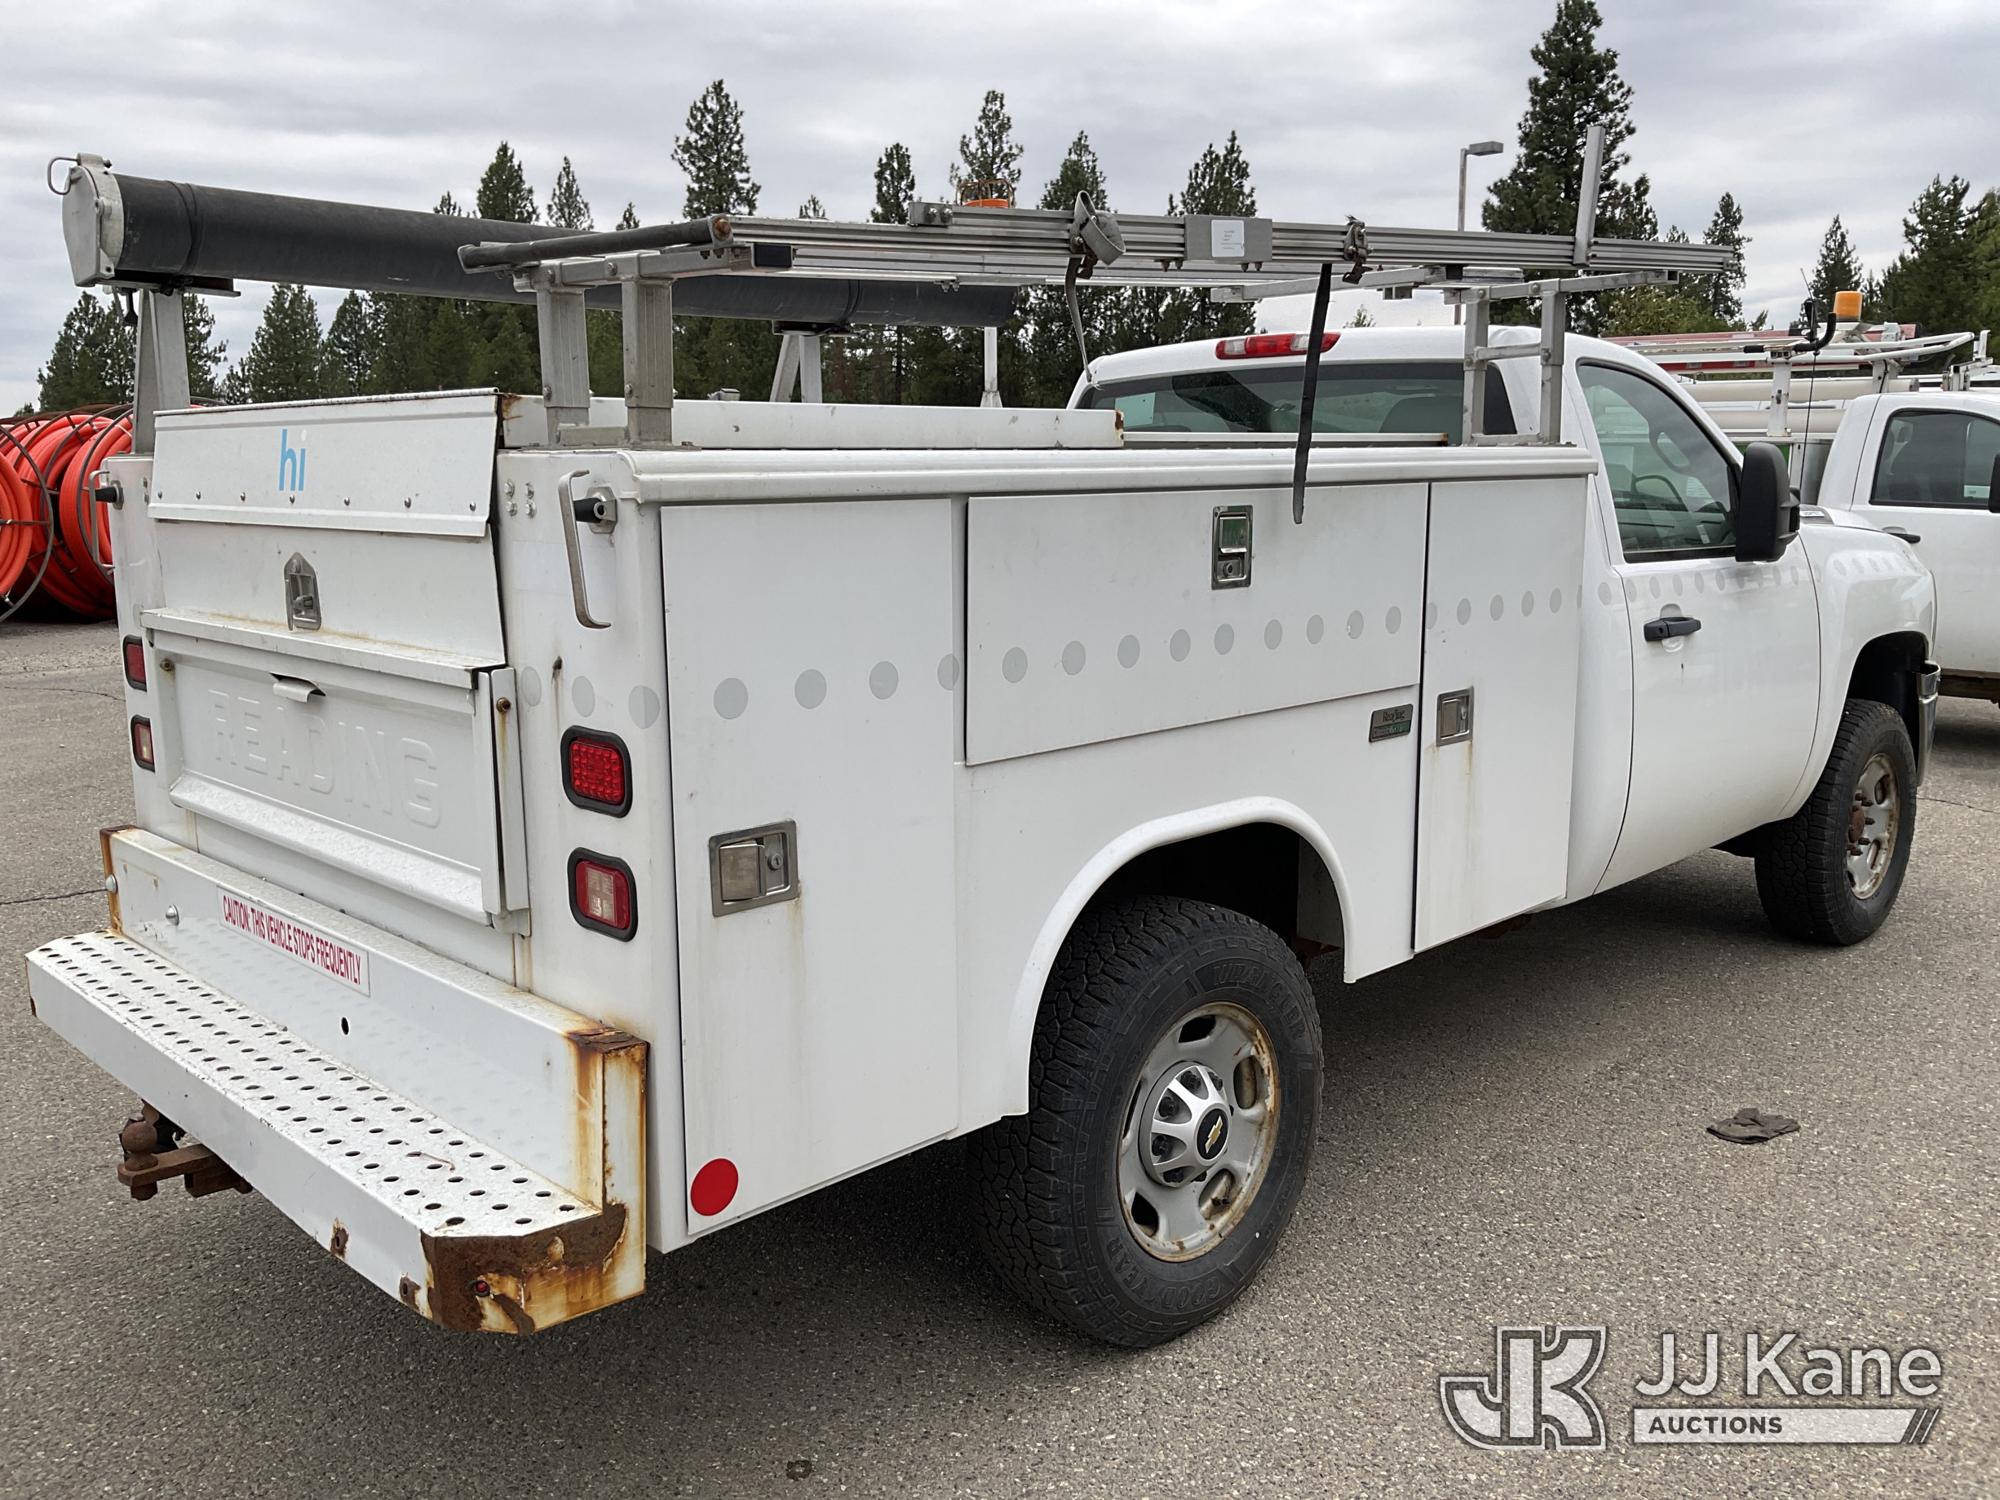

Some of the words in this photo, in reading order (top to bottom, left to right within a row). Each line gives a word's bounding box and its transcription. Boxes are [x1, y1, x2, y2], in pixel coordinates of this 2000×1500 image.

[279, 429, 306, 491] hi
[207, 689, 442, 829] READING
[251, 908, 265, 939] THIS
[265, 915, 293, 953] VEHICLE
[294, 927, 314, 964] STOPS
[316, 936, 361, 985] FREQUENTLY
